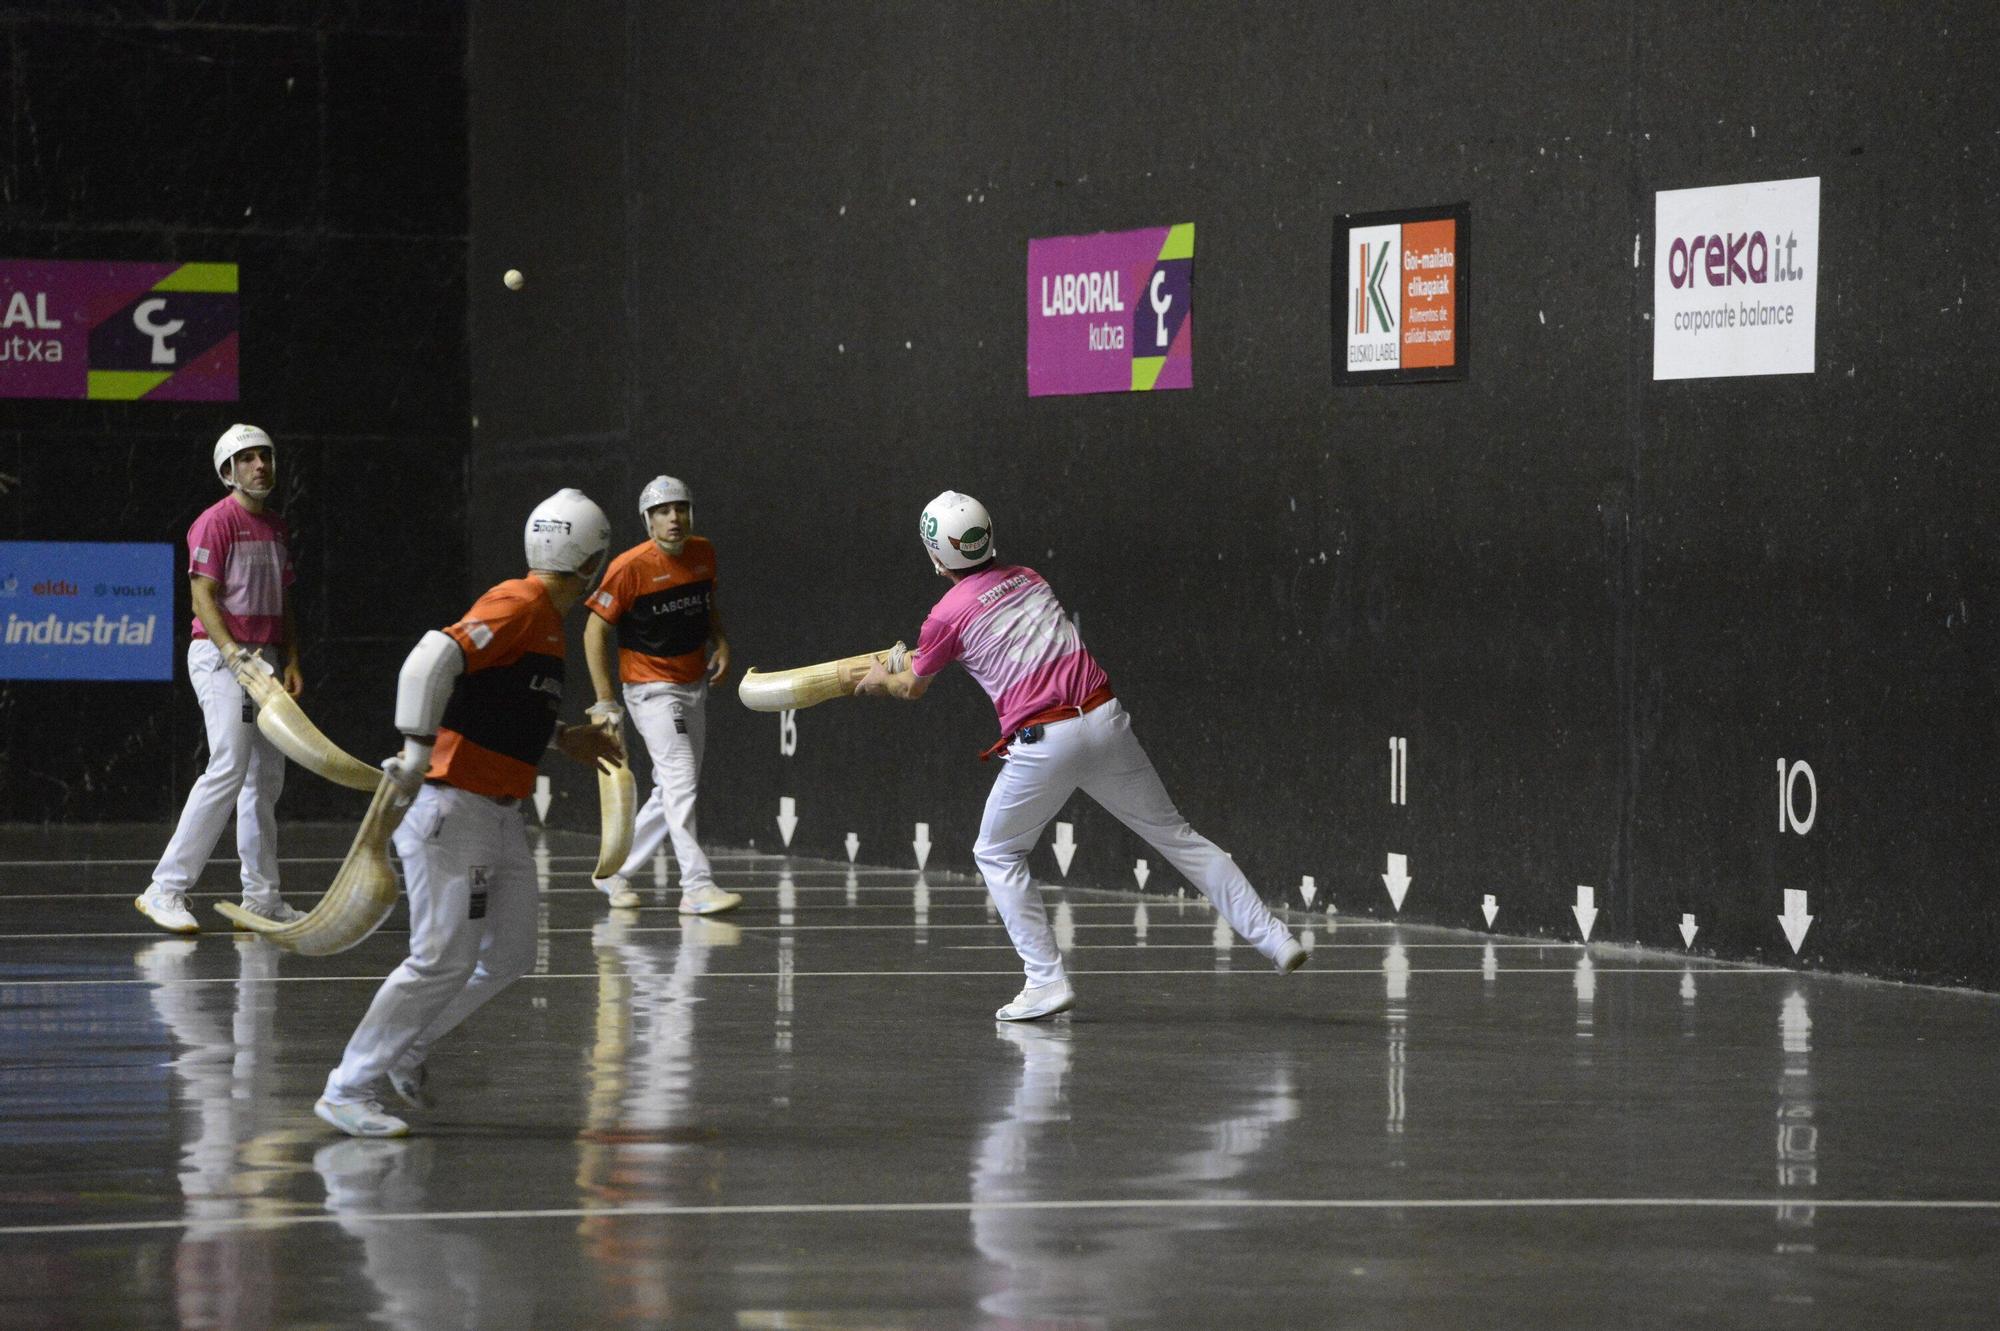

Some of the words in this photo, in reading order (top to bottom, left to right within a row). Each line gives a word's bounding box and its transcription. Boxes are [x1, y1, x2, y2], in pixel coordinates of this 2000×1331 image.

[1404, 247, 1454, 270] Goi-mailako
[1669, 230, 1768, 289] oreka
[1042, 270, 1125, 316] LABORAL
[1408, 275, 1449, 301] elikagaiak
[0, 292, 62, 329] AL
[1409, 307, 1439, 323] Alimentos
[1440, 305, 1448, 321] de
[1674, 302, 1736, 336] corporate
[1739, 300, 1794, 327] balance
[1089, 322, 1124, 350] kutxa
[1404, 328, 1427, 344] calidad
[1427, 327, 1453, 345] superior
[1350, 344, 1374, 363] EUSKO
[1375, 342, 1399, 361] LABEL
[32, 580, 79, 596] eldu
[652, 595, 703, 615] LABORAL
[5, 613, 157, 645] industrial
[1389, 736, 1407, 806] 11
[1777, 757, 1817, 835] 10
